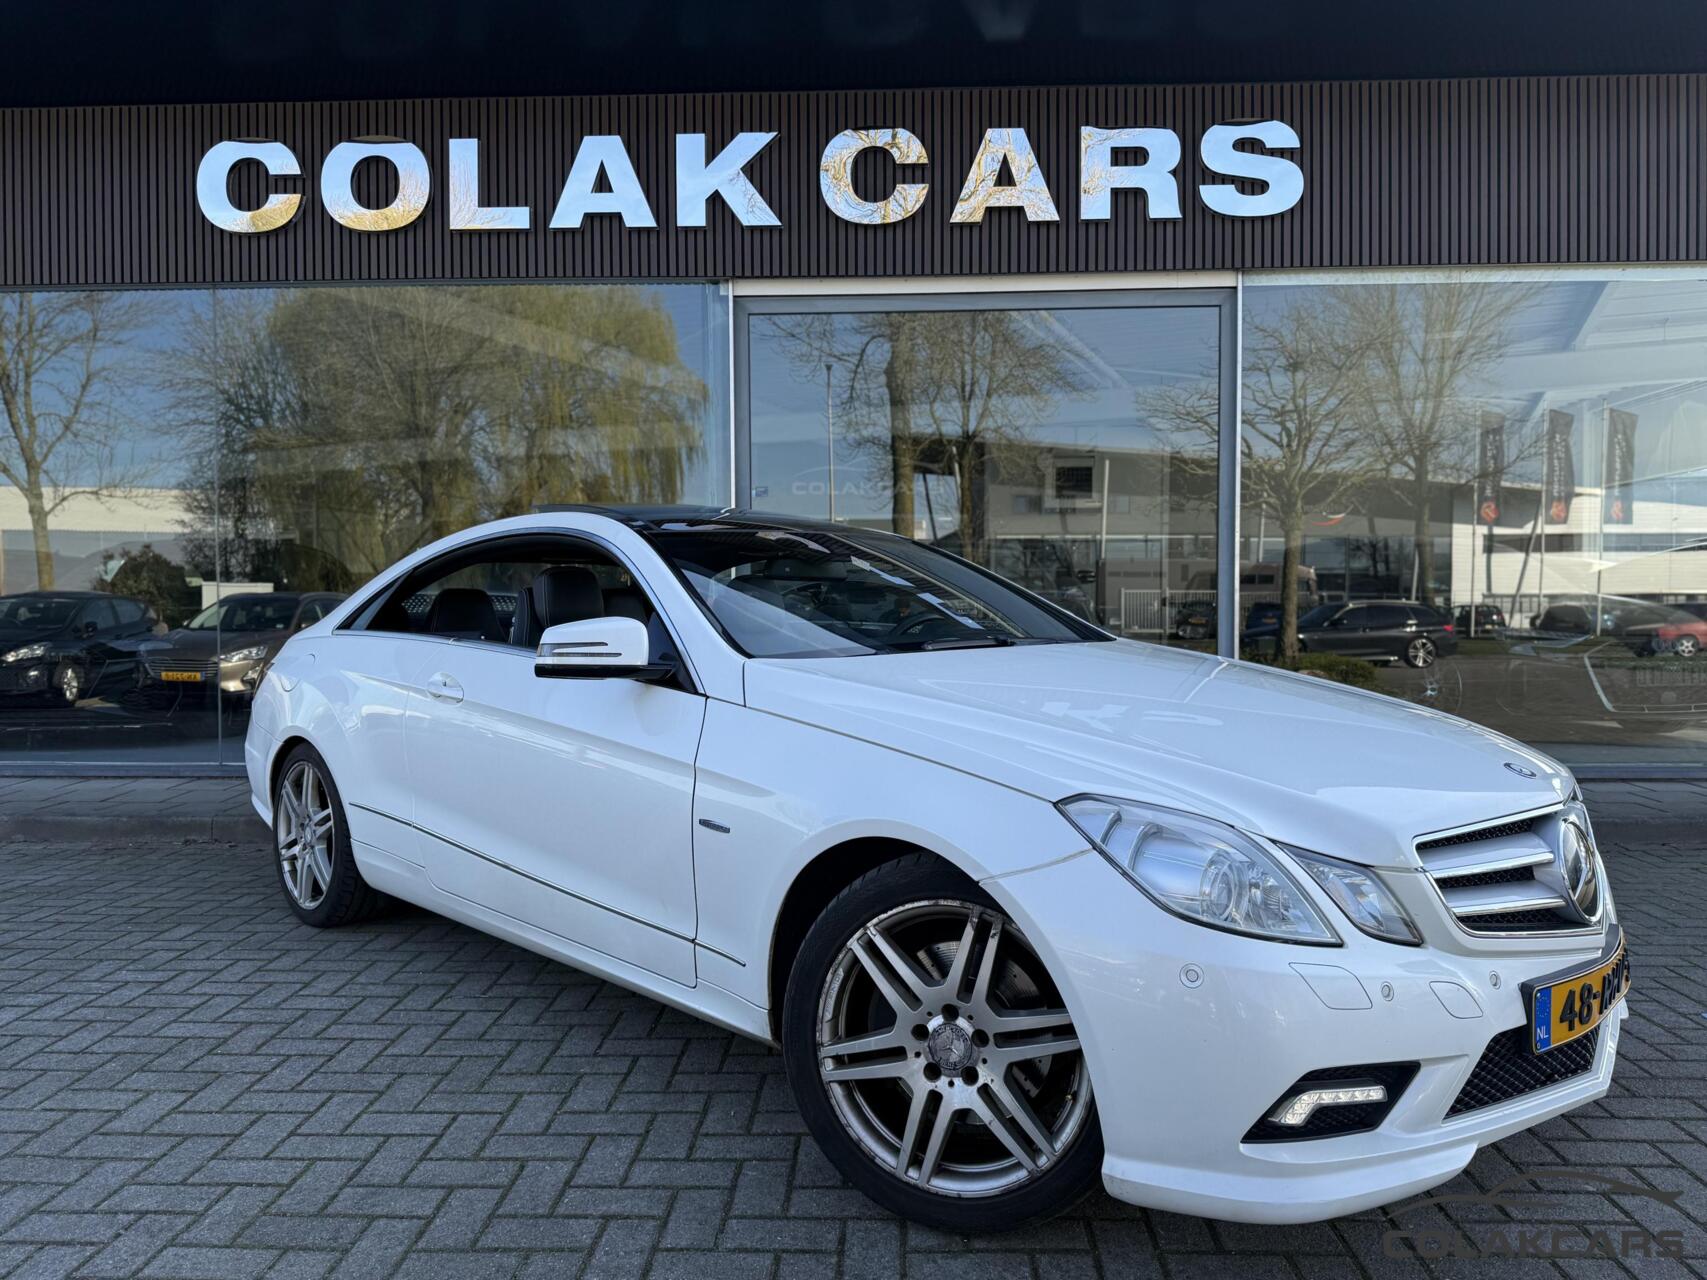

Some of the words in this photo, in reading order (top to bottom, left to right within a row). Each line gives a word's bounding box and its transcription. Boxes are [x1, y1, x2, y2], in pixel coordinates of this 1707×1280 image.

[196, 131, 784, 234] COLAK
[819, 119, 1305, 226] CARS
[1536, 1025, 1549, 1041] NL
